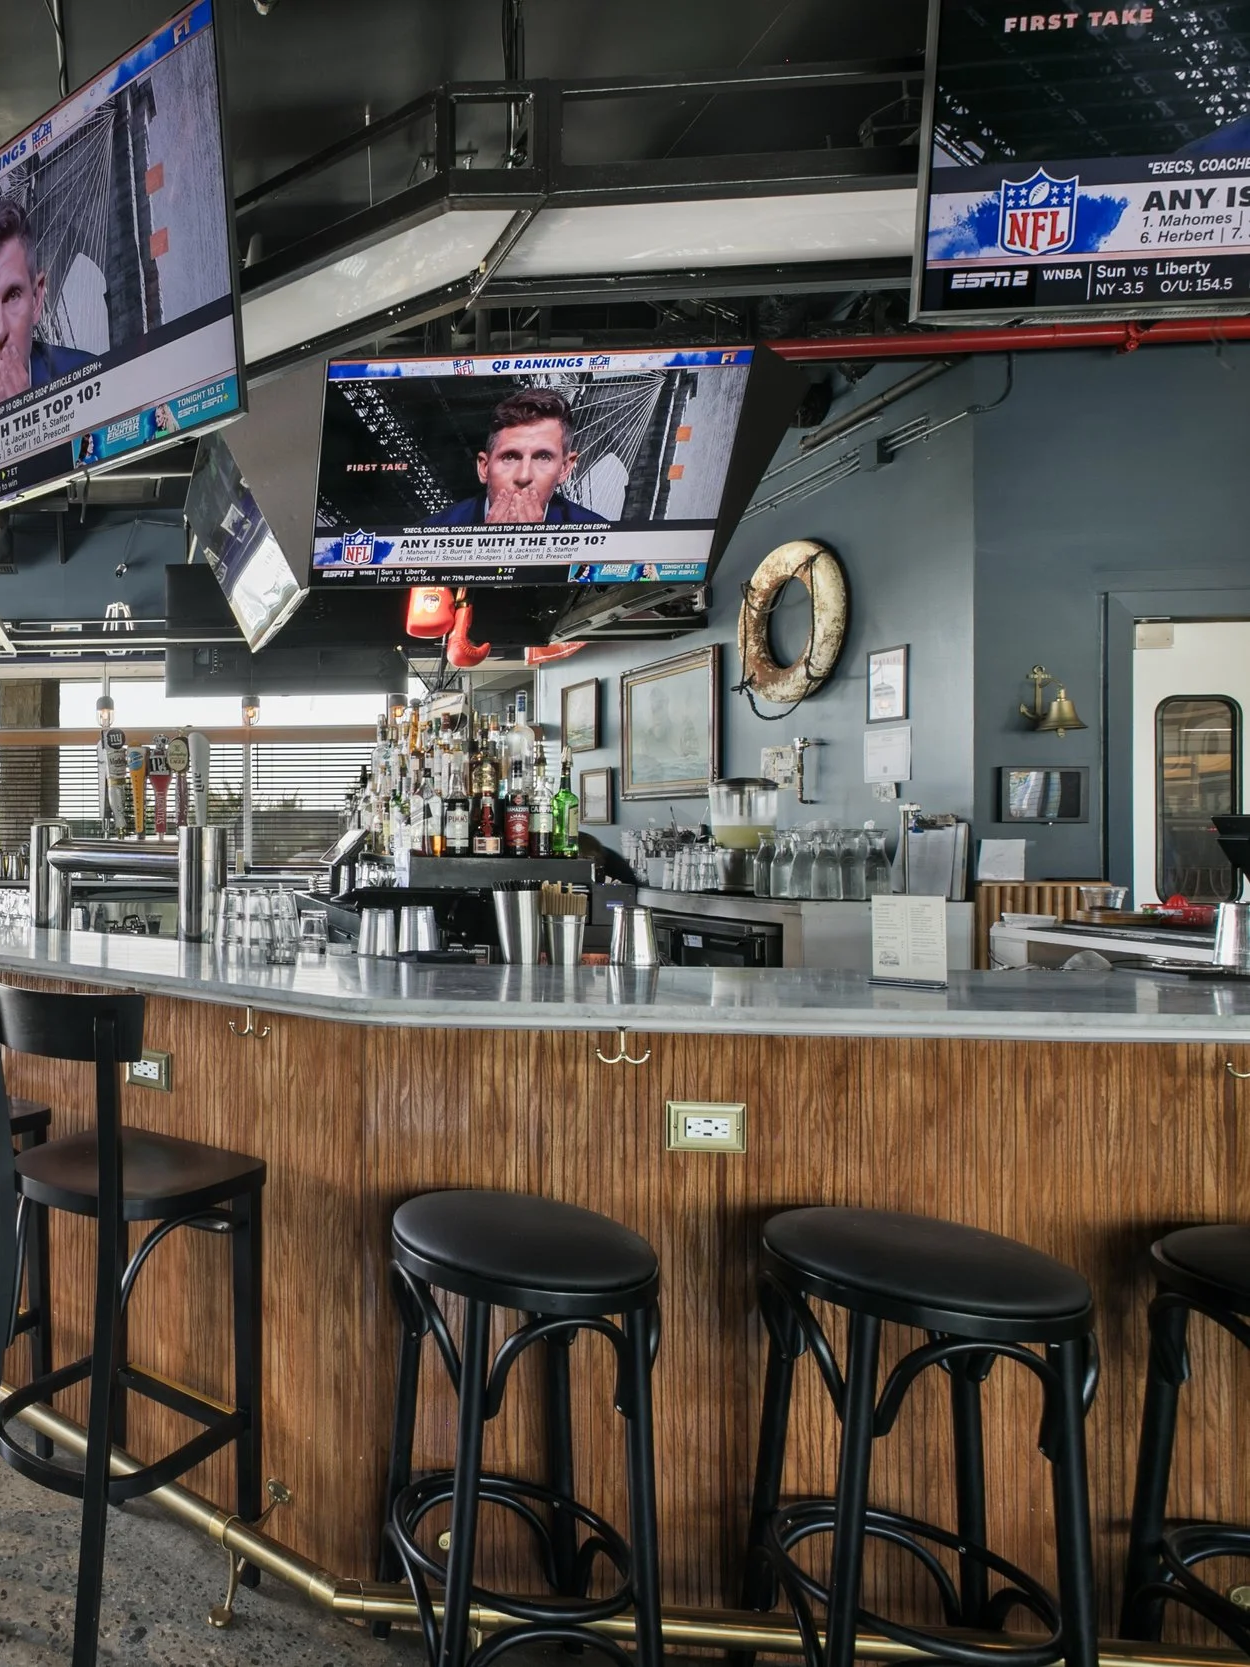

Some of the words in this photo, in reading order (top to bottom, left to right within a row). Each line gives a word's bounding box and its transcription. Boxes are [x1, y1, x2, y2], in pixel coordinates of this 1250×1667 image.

[1004, 13, 1079, 33] FIRST
[1088, 8, 1154, 27] TAKE
[173, 15, 190, 45] FT
[1142, 187, 1217, 212] ANY
[1142, 216, 1153, 228] 1.
[1158, 213, 1233, 227] Mahomes
[1007, 210, 1065, 251] NFL
[1140, 231, 1152, 244] 6.
[1157, 228, 1214, 243] Herbert
[1231, 227, 1243, 239] 7.
[1042, 268, 1083, 281] WNBA
[1096, 265, 1126, 278] Sun
[1133, 266, 1149, 277] vs
[1155, 261, 1211, 276] Liberty
[1095, 283, 1116, 296] NY
[1117, 281, 1144, 294] -3.5
[1160, 280, 1193, 293] O/U:
[1196, 278, 1233, 291] 154.5
[492, 360, 510, 373] QB
[513, 357, 584, 370] RANKINGS
[720, 351, 738, 364] FT
[5, 402, 11, 412] 10
[23, 392, 34, 403] FOR
[49, 374, 72, 393] ARTICLE
[72, 370, 82, 381] ON
[82, 361, 102, 377] ESPN+
[177, 391, 207, 407] TONIGHT
[207, 387, 214, 396] 10
[216, 382, 226, 393] ET
[13, 408, 40, 432] THE
[43, 394, 73, 419] TOP
[77, 381, 101, 404] 10?
[177, 404, 199, 419] ESPN
[11, 428, 36, 444] Jackson
[49, 410, 75, 428] Stafford
[107, 422, 140, 442] FIGHTER
[108, 414, 140, 433] ULTIMATE
[13, 441, 27, 453] Goff
[43, 424, 71, 441] Prescott
[11, 466, 18, 475] ET
[346, 464, 378, 472] FIRST
[380, 463, 408, 471] TAKE
[8, 479, 18, 489] win
[400, 539, 430, 548] ANY
[434, 538, 474, 548] ISSUE
[478, 537, 515, 547] WITH
[520, 537, 547, 546] THE
[551, 536, 580, 546] TOP
[584, 535, 607, 545] 10?
[346, 546, 369, 563] NFL
[404, 568, 427, 576] Liberty
